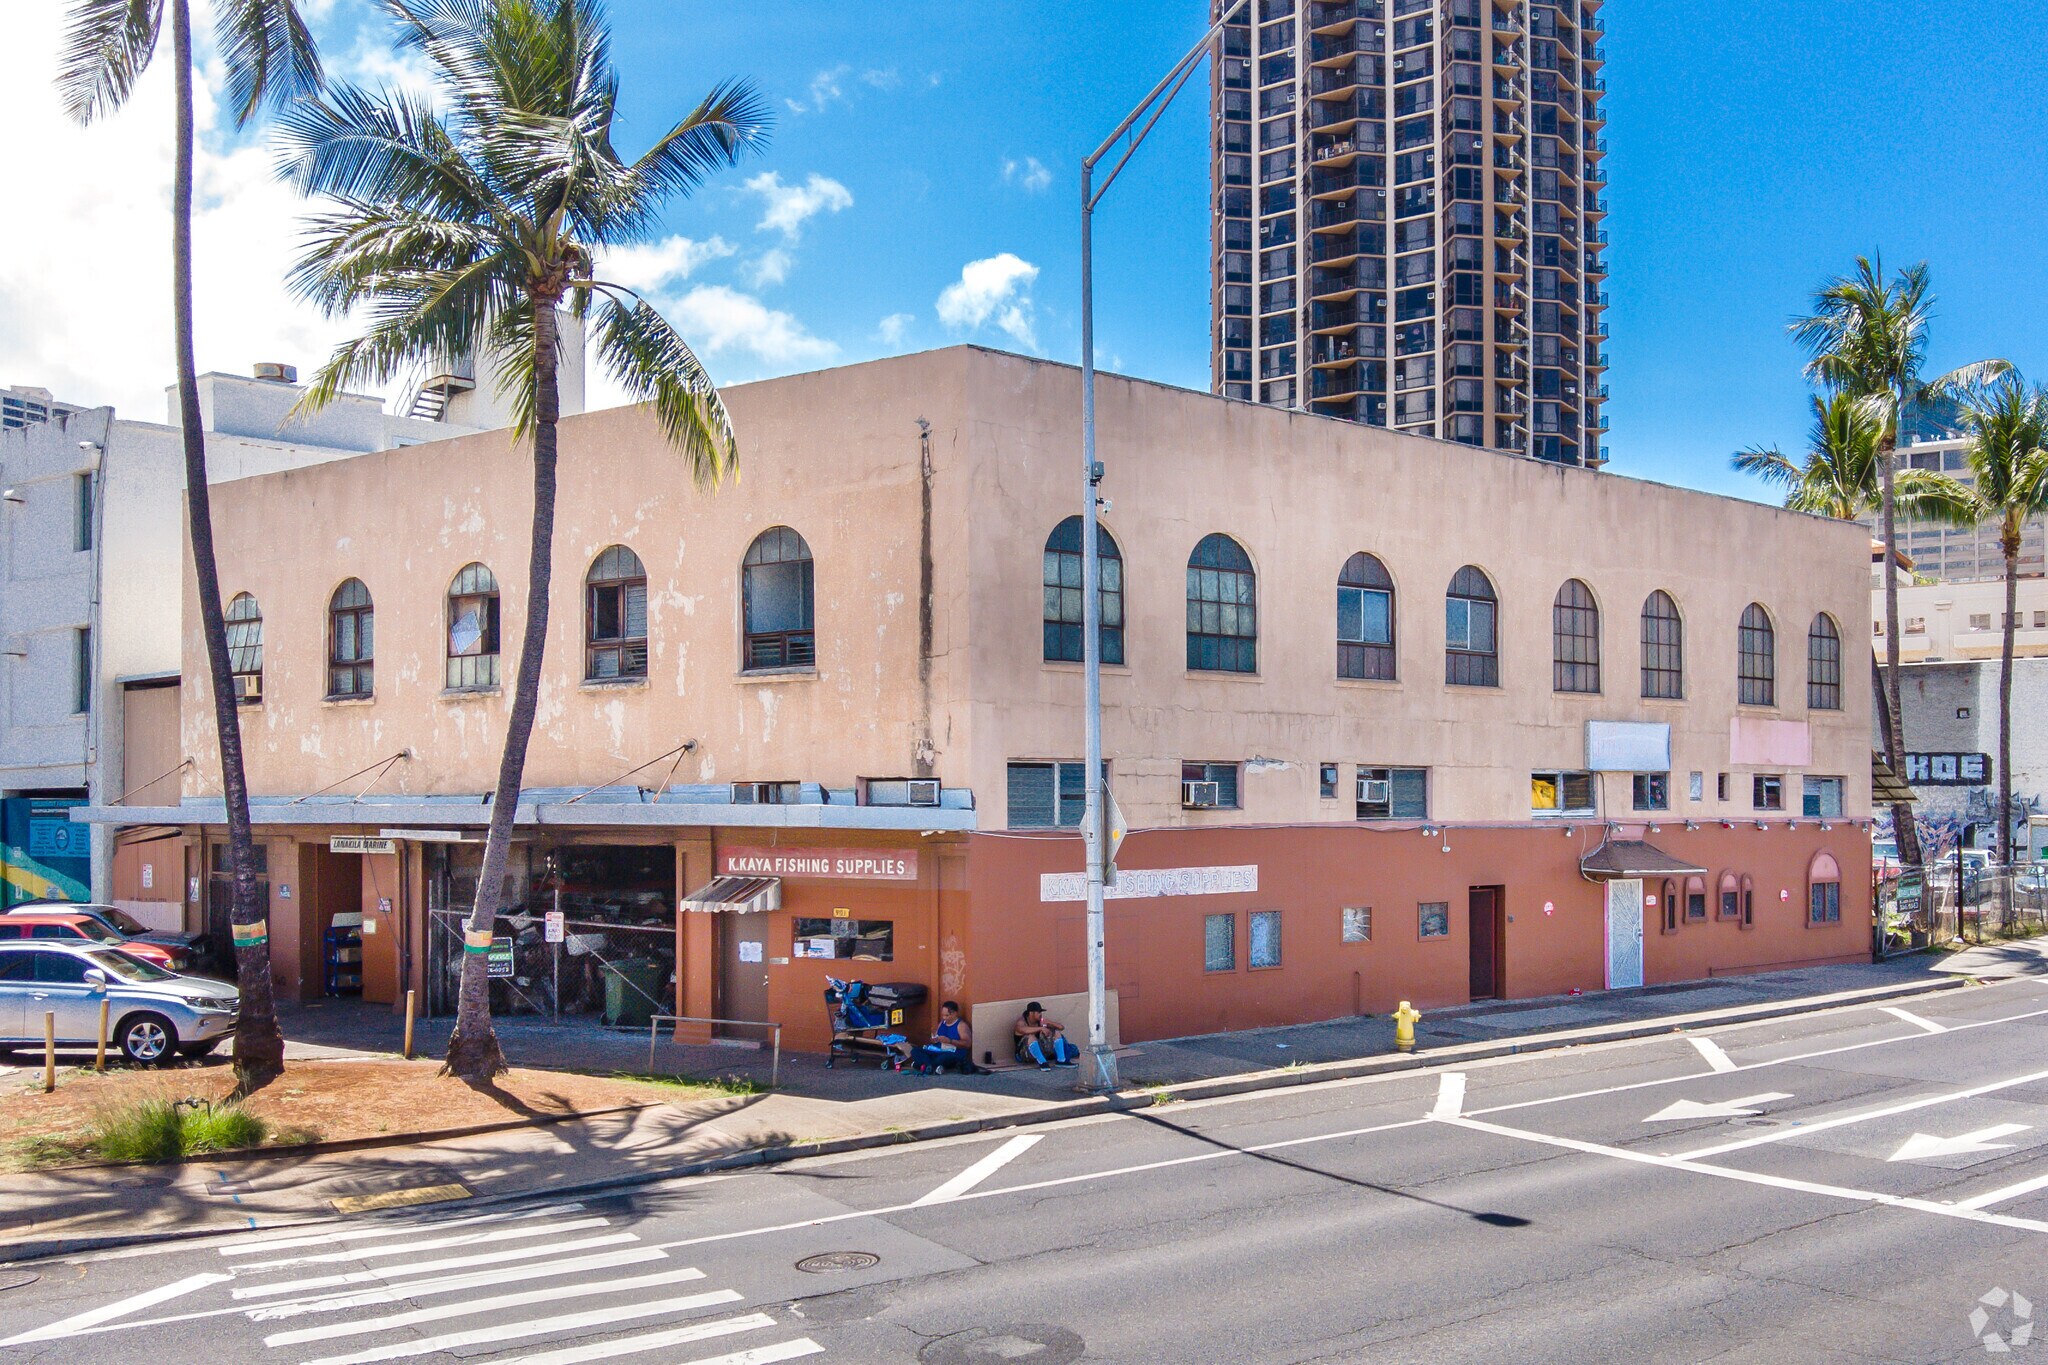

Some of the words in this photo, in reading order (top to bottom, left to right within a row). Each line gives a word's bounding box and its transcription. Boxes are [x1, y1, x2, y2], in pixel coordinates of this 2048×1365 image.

[363, 840, 388, 850] MARINE
[728, 857, 772, 872] K.KAYA
[775, 858, 830, 873] FISHING
[836, 859, 905, 875] SUPPLIES
[1116, 873, 1176, 894] ISHING
[1180, 870, 1252, 889] SUPPLIES
